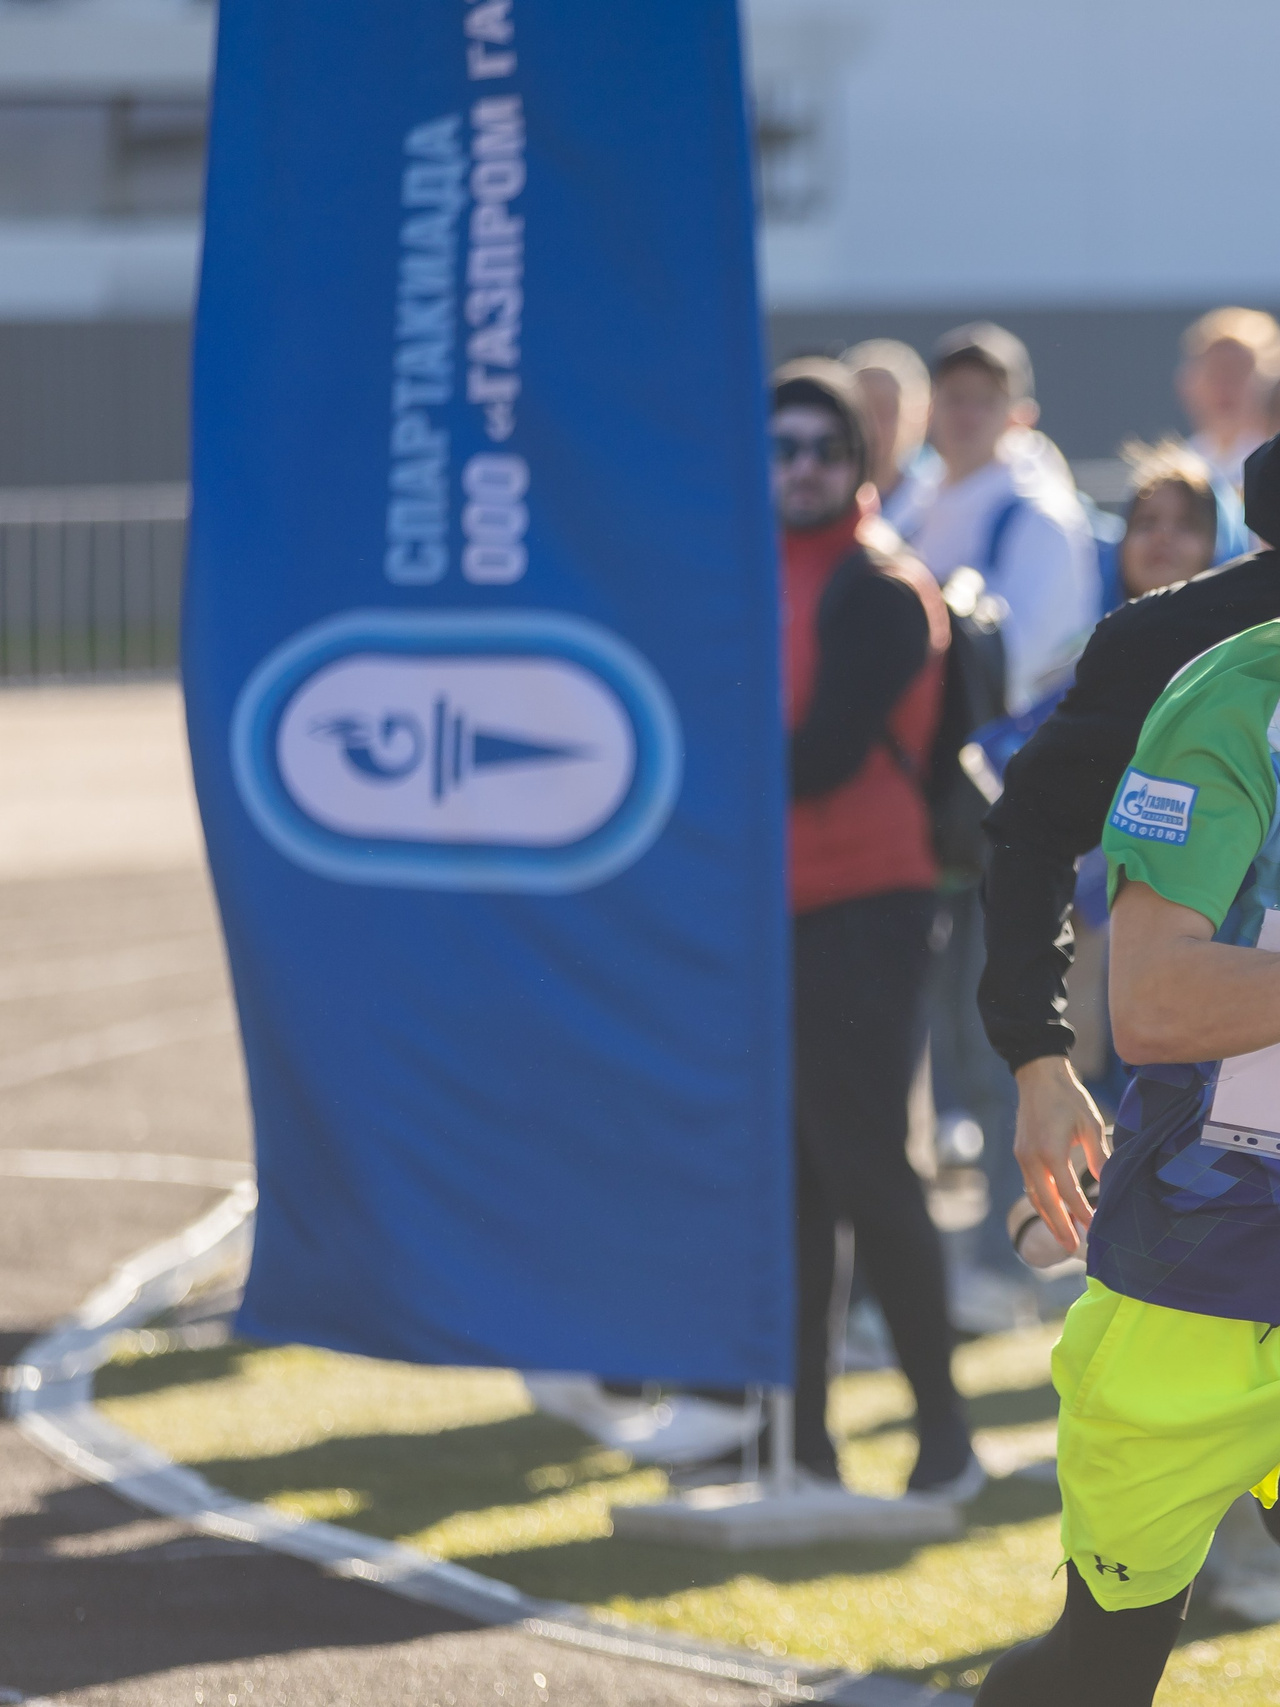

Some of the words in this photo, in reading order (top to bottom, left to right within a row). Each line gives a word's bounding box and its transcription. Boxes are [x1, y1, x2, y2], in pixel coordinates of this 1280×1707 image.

[463, 0, 517, 80] ГА
[386, 115, 466, 584] СПАРТАКИАДА
[462, 453, 529, 585] ООО
[1112, 814, 1185, 842] ПРОФСОЮЗ
[1145, 795, 1186, 814] ГАЗПРОМ
